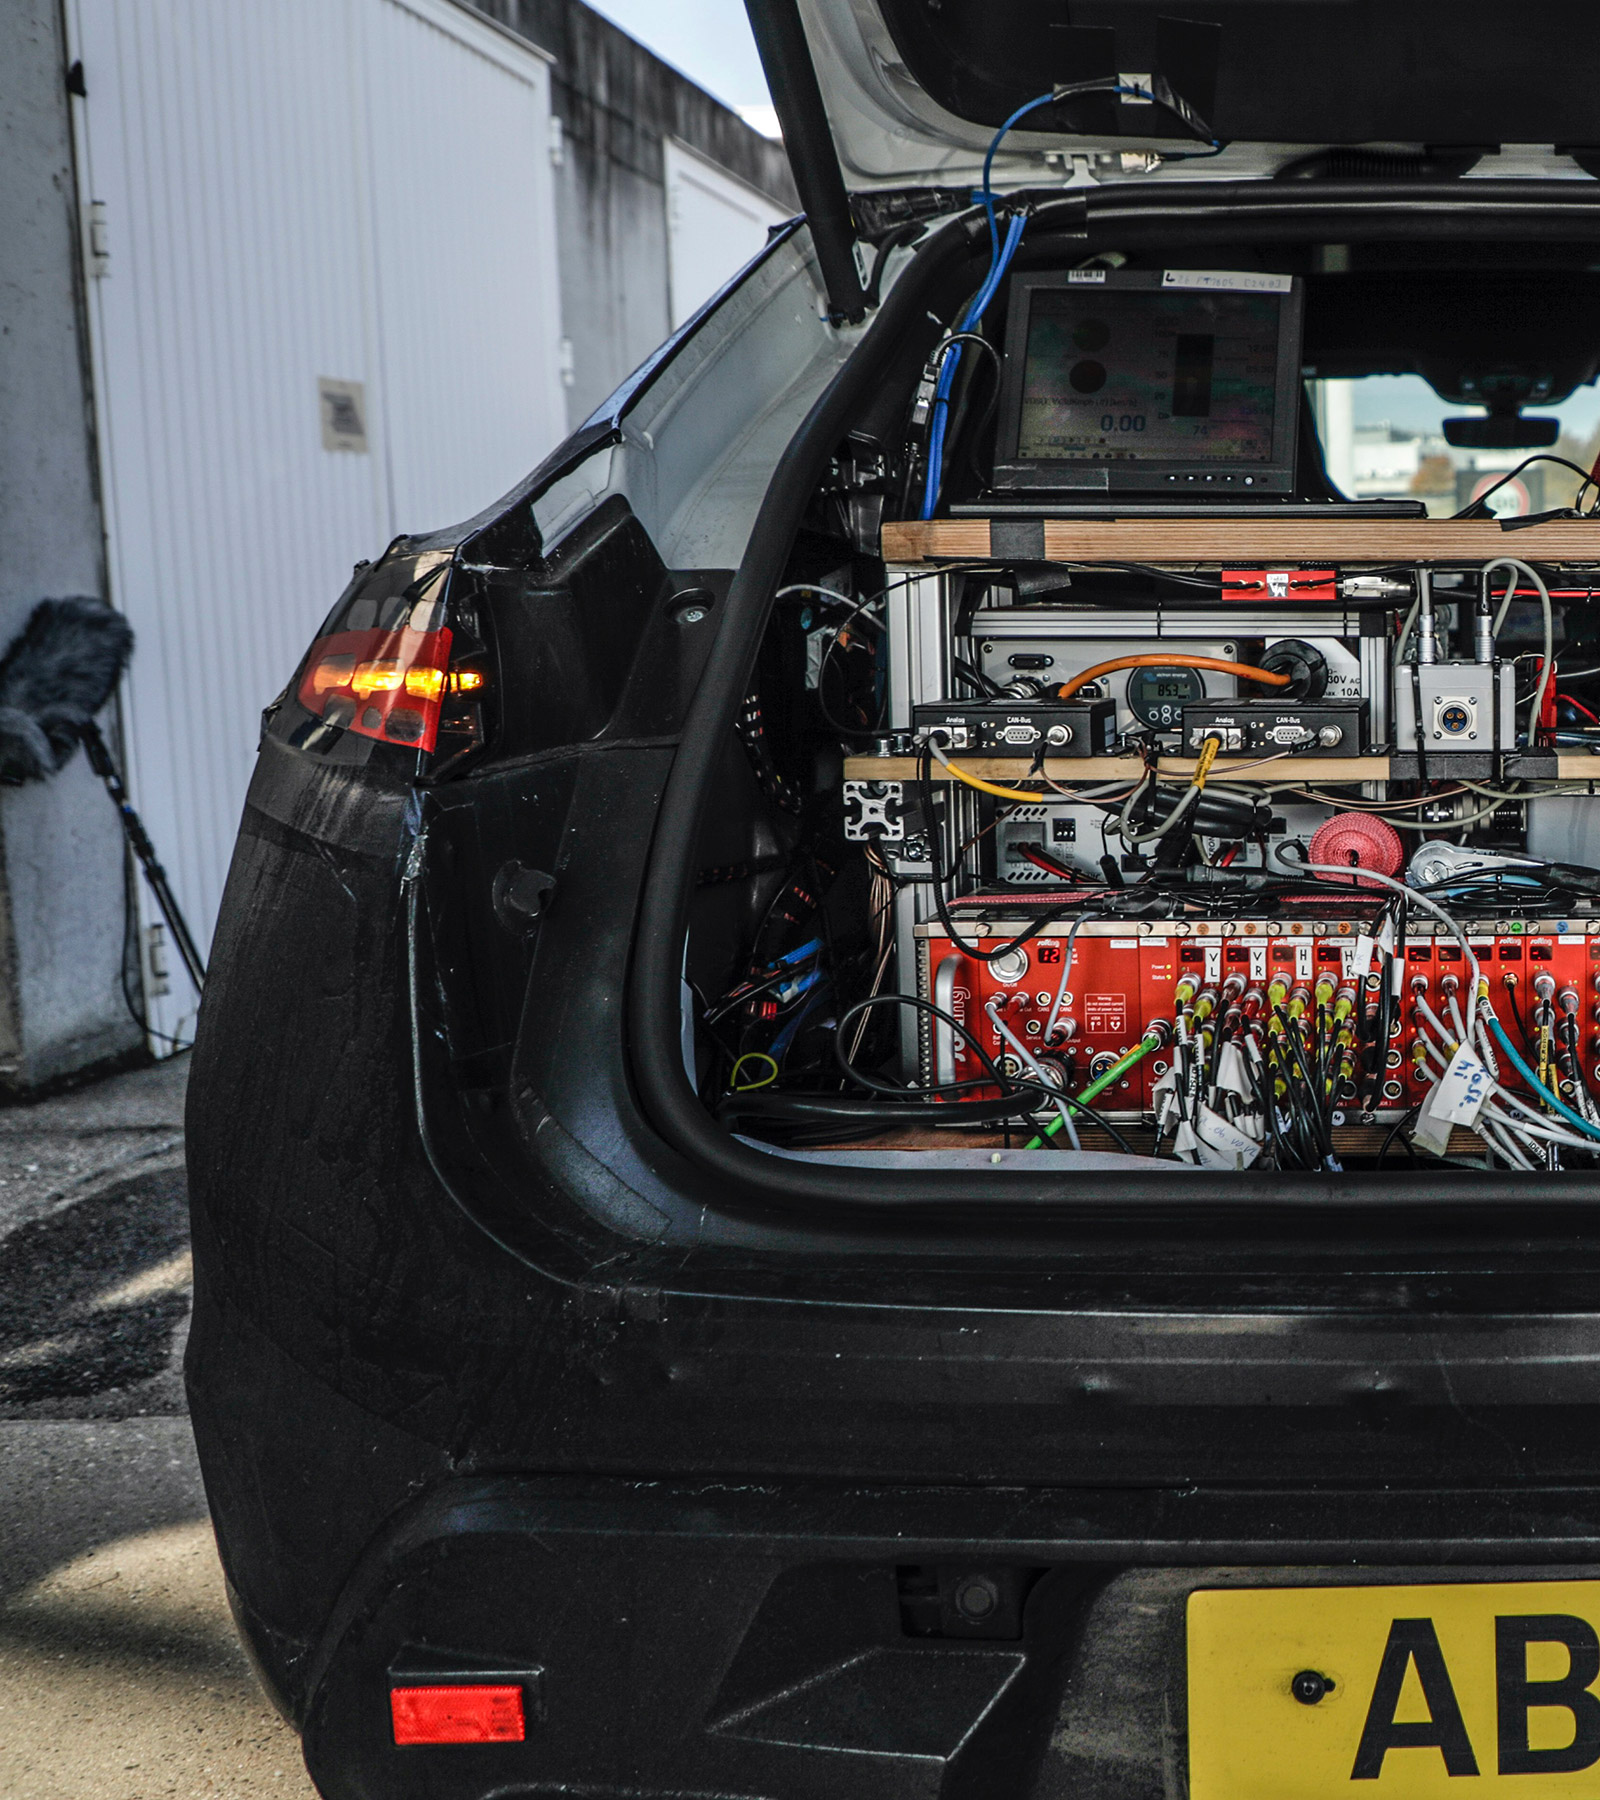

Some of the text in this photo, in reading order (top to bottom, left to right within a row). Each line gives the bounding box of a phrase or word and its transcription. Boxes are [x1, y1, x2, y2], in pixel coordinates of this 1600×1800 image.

[1100, 414, 1147, 432] 0.00
[1328, 676, 1347, 684] 30V
[1341, 688, 1360, 697] 10A
[1215, 717, 1234, 725] Analog
[1037, 939, 1060, 948] softing
[1499, 937, 1522, 946] softing
[1530, 937, 1553, 946] softing
[1209, 953, 1218, 962] V
[1253, 952, 1262, 960] V
[1300, 949, 1307, 960] H
[1210, 967, 1217, 977] L
[1255, 966, 1262, 976] R
[1301, 966, 1308, 975] L
[1453, 1060, 1475, 1080] hi
